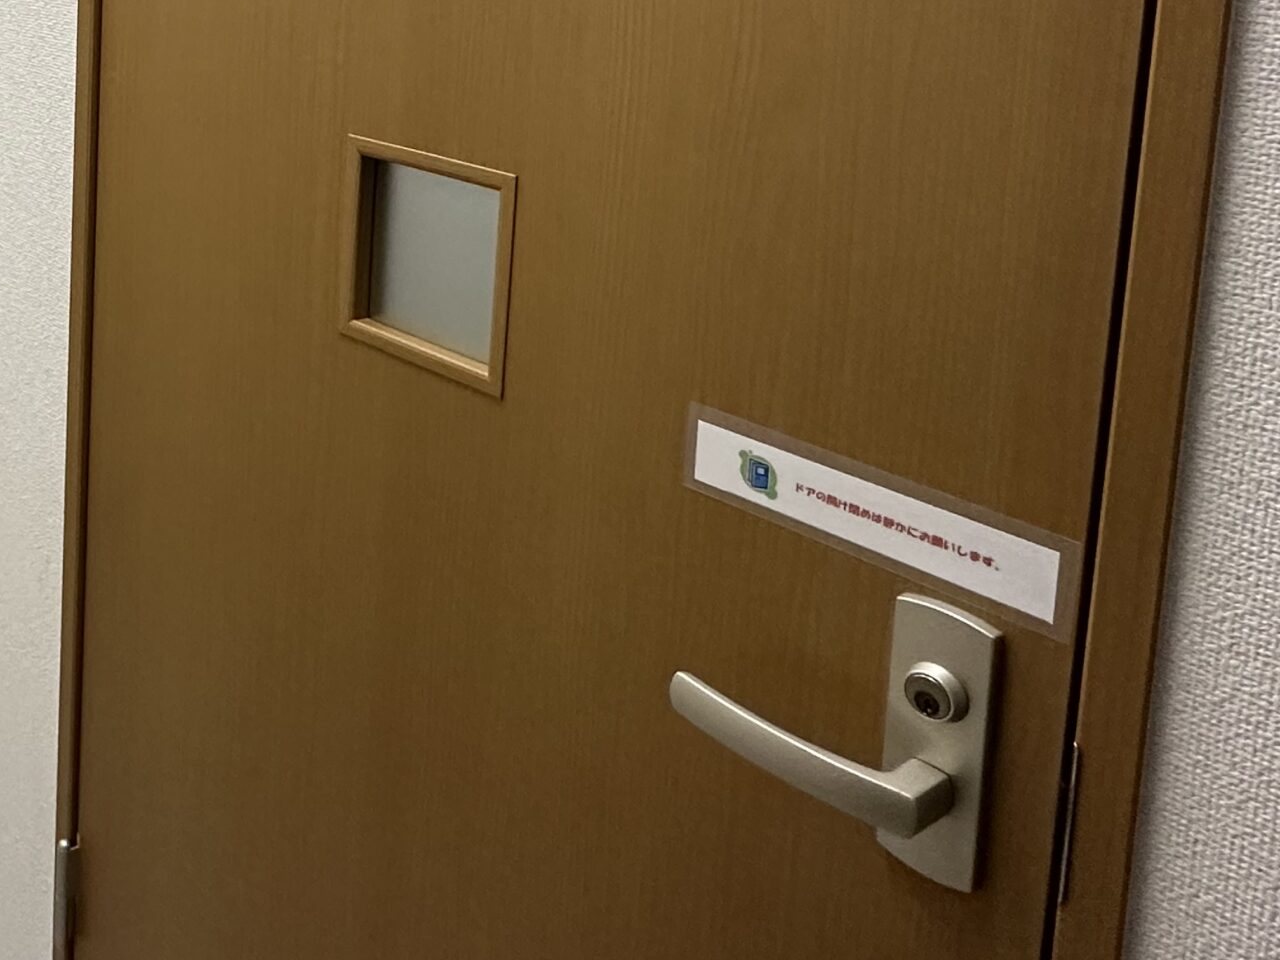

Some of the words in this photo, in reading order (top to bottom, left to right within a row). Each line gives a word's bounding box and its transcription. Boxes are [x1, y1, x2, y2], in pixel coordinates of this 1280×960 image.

[795, 482, 1000, 572] ドアの開け閉めは静かにお願いします。
